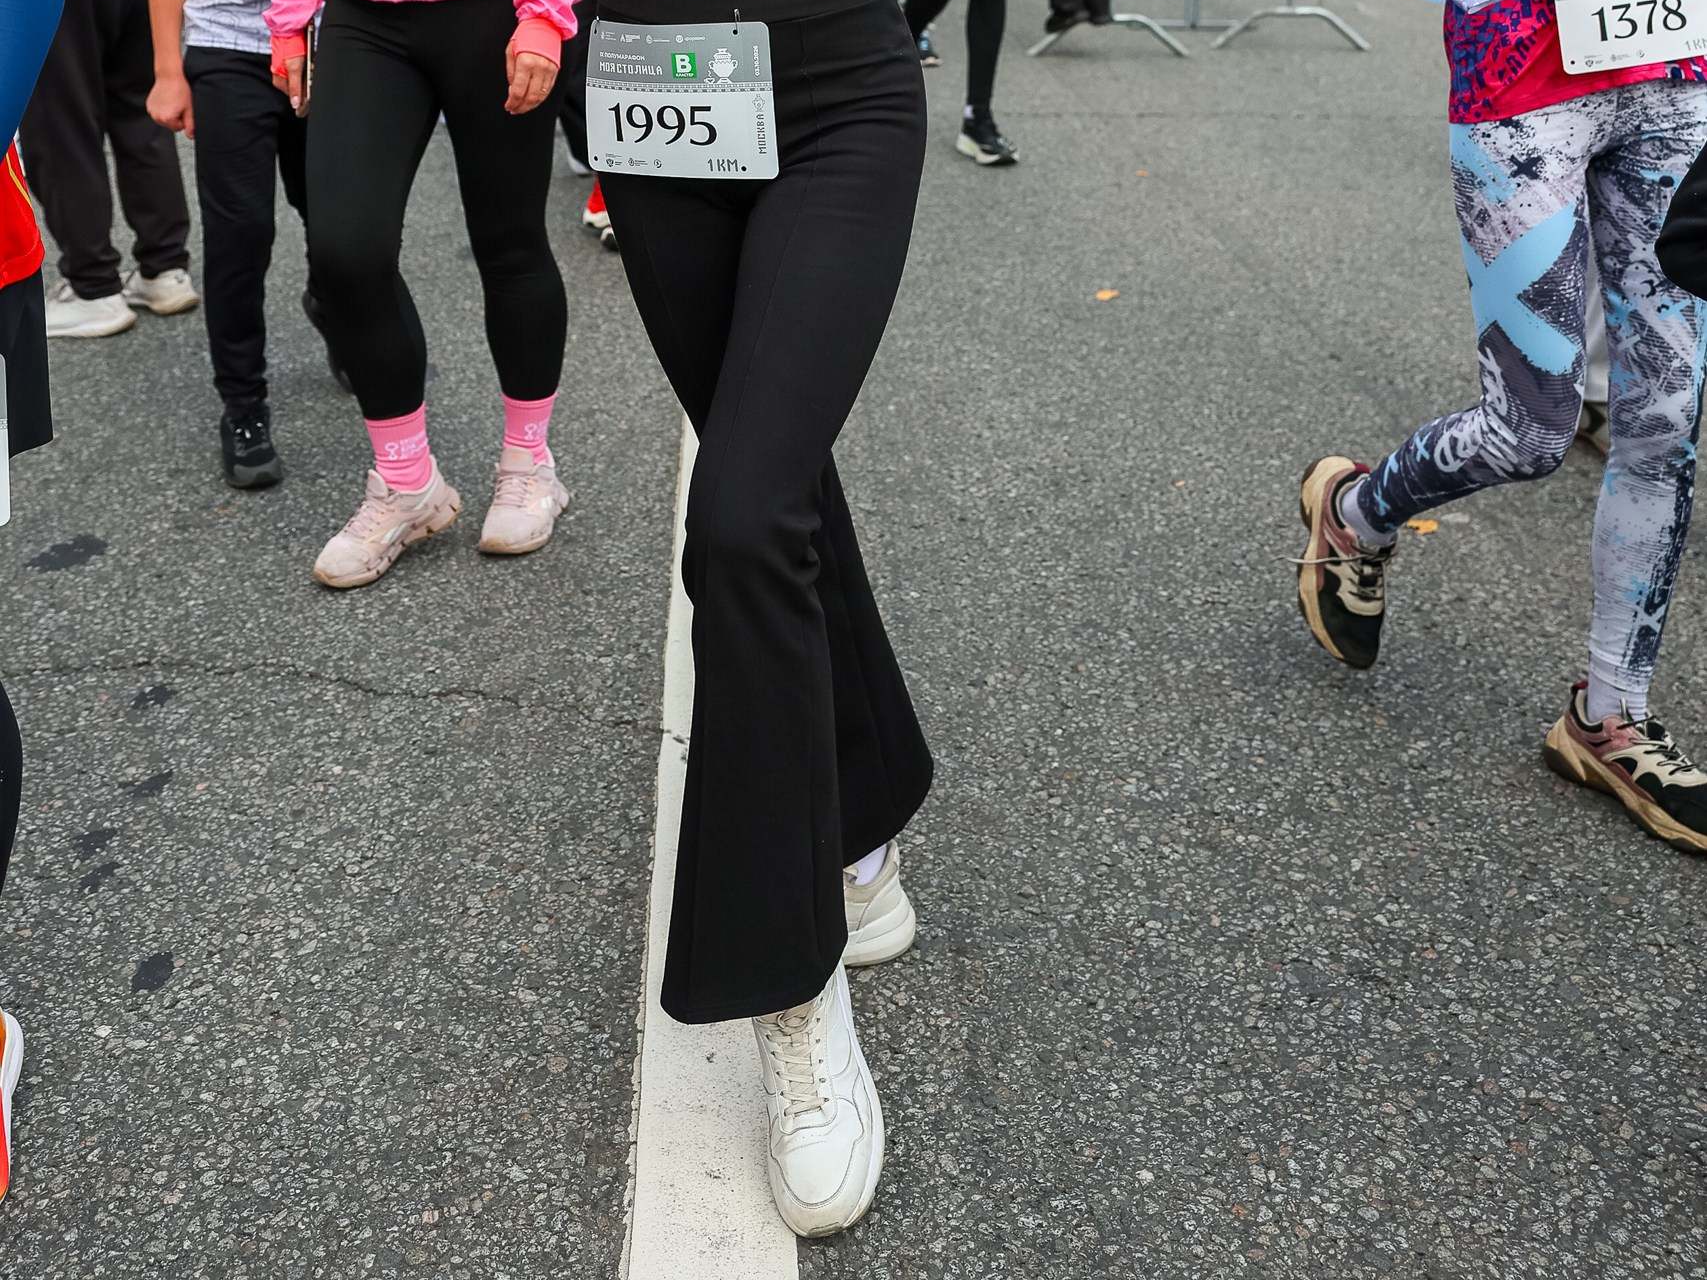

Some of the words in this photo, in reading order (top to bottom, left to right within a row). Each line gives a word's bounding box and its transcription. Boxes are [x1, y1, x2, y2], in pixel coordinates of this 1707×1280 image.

[616, 63, 663, 76] СТОЛИЦА
[608, 102, 717, 146] 1995
[756, 113, 767, 155] МОСКВА
